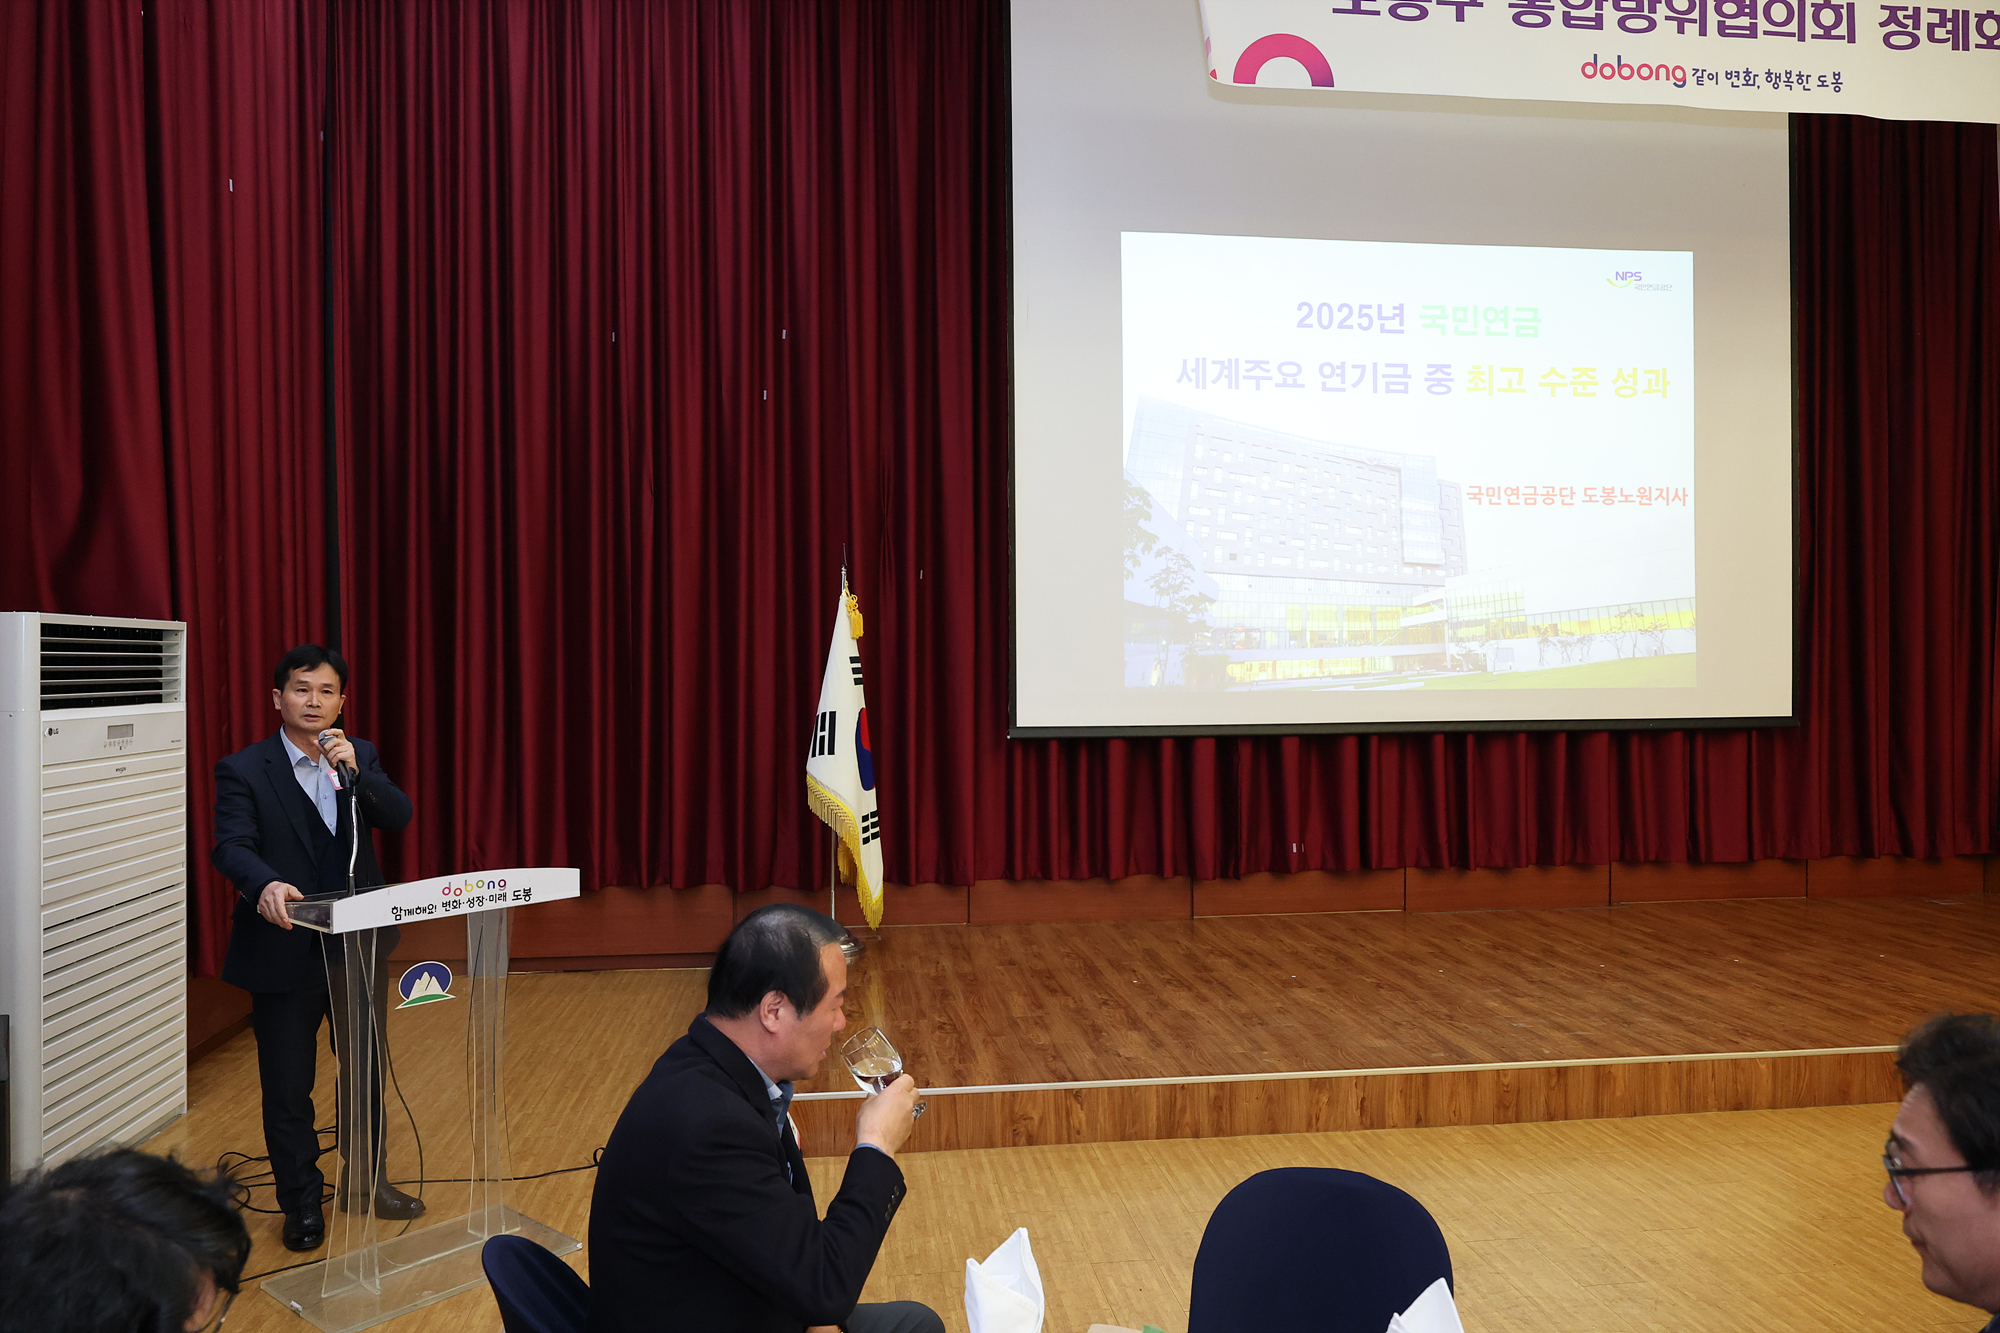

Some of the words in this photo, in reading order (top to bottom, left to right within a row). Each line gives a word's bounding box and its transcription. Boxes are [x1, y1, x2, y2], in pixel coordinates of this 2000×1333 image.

[1581, 53, 1687, 88] dobong
[1692, 68, 1719, 86] 같이
[1725, 67, 1760, 89] 변화,
[1765, 69, 1811, 91] 행복한
[1816, 71, 1844, 93] 도봉
[1615, 271, 1642, 281] NPS
[1296, 301, 1405, 334] 2025년
[1419, 304, 1542, 338] 국민연금
[1176, 357, 1305, 391] 세계주요
[1318, 361, 1412, 394] 연기금
[1424, 363, 1454, 395] 중
[1466, 364, 1527, 396] 최고
[1538, 366, 1599, 397] 수준
[1611, 367, 1671, 398] 성과
[1466, 485, 1576, 506] 국민연금공단
[1581, 486, 1689, 506] 도봉노원지사
[442, 879, 507, 897] dobong
[391, 903, 437, 921] 함께해요!
[511, 887, 532, 902] 도봉
